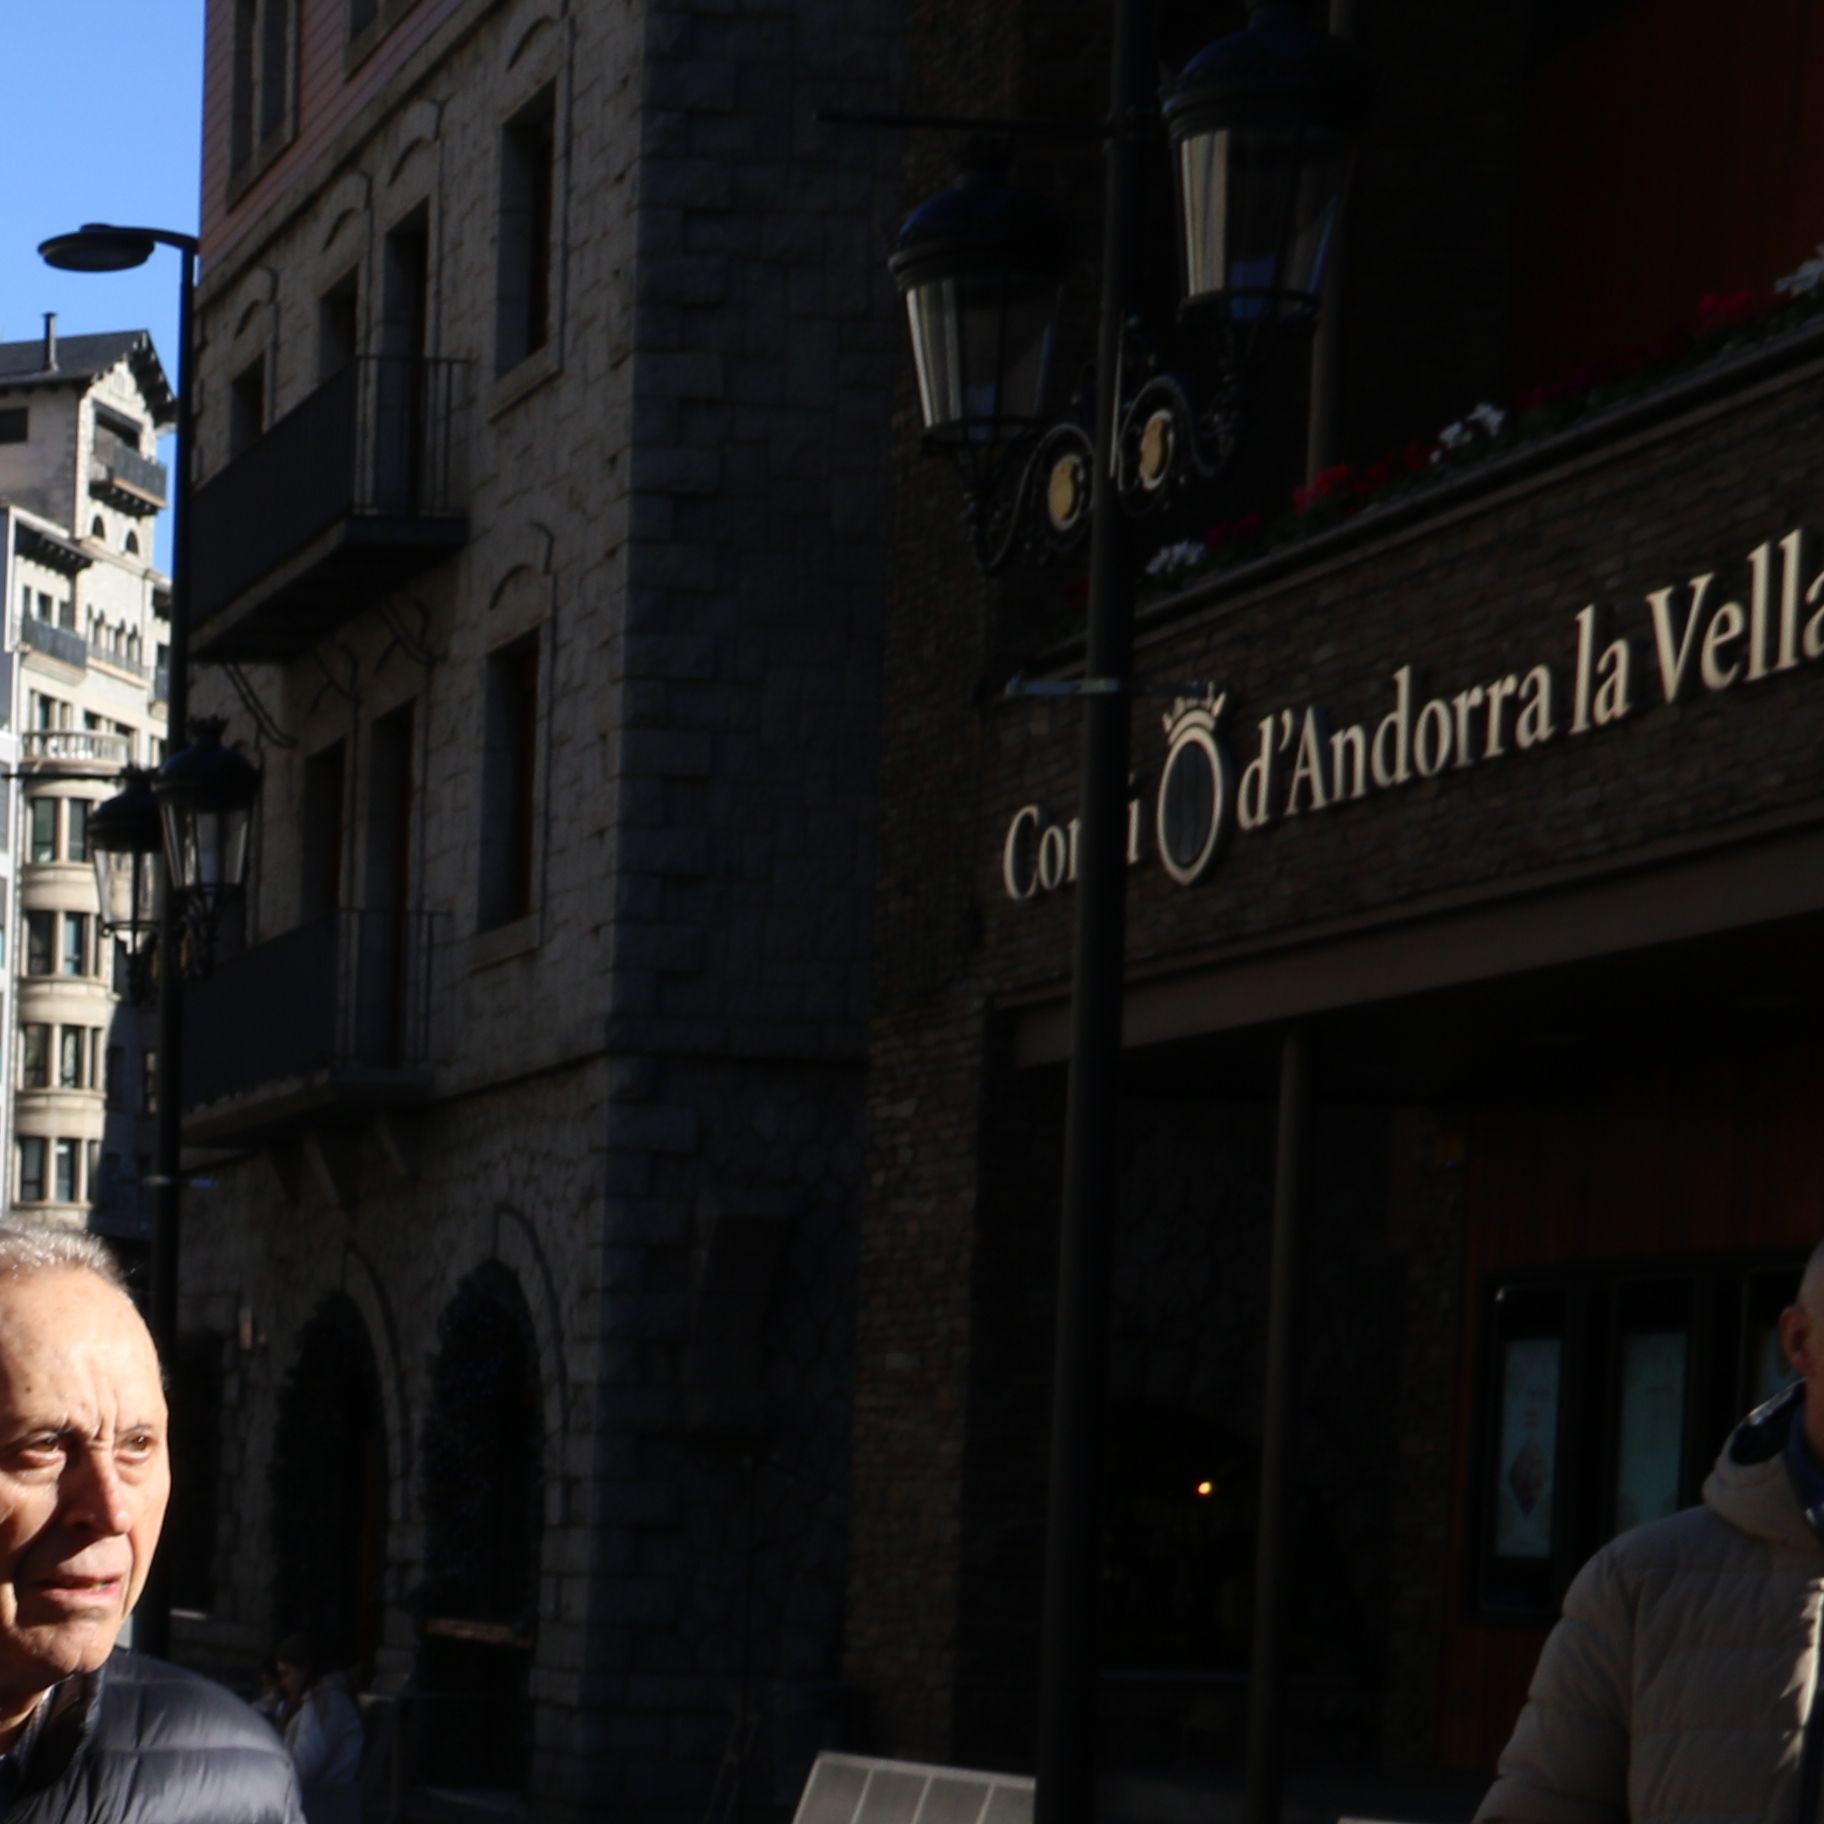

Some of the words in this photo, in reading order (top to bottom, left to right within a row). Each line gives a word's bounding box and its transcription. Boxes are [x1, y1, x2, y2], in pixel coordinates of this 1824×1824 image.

[1003, 771, 1140, 900] Co
[1568, 603, 1632, 736] la
[1645, 528, 1824, 705] Vella
